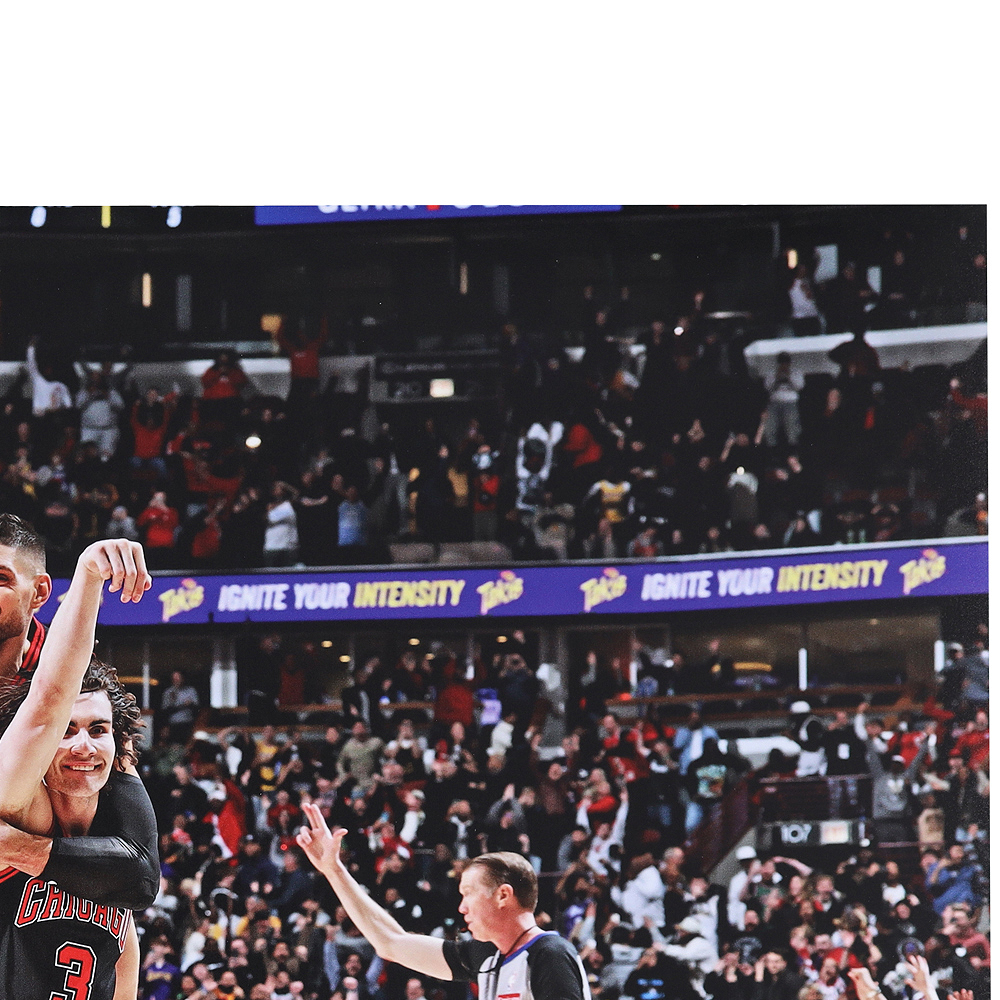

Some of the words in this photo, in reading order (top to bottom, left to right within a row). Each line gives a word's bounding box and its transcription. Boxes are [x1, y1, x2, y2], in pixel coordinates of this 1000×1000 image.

[217, 583, 290, 611] IGNITE
[293, 581, 352, 609] YOUR
[353, 579, 466, 607] INTENSITY
[640, 570, 714, 601] IGNITE
[717, 566, 774, 596] YOUR
[776, 559, 889, 592] INTENSITY
[781, 823, 812, 844] 107
